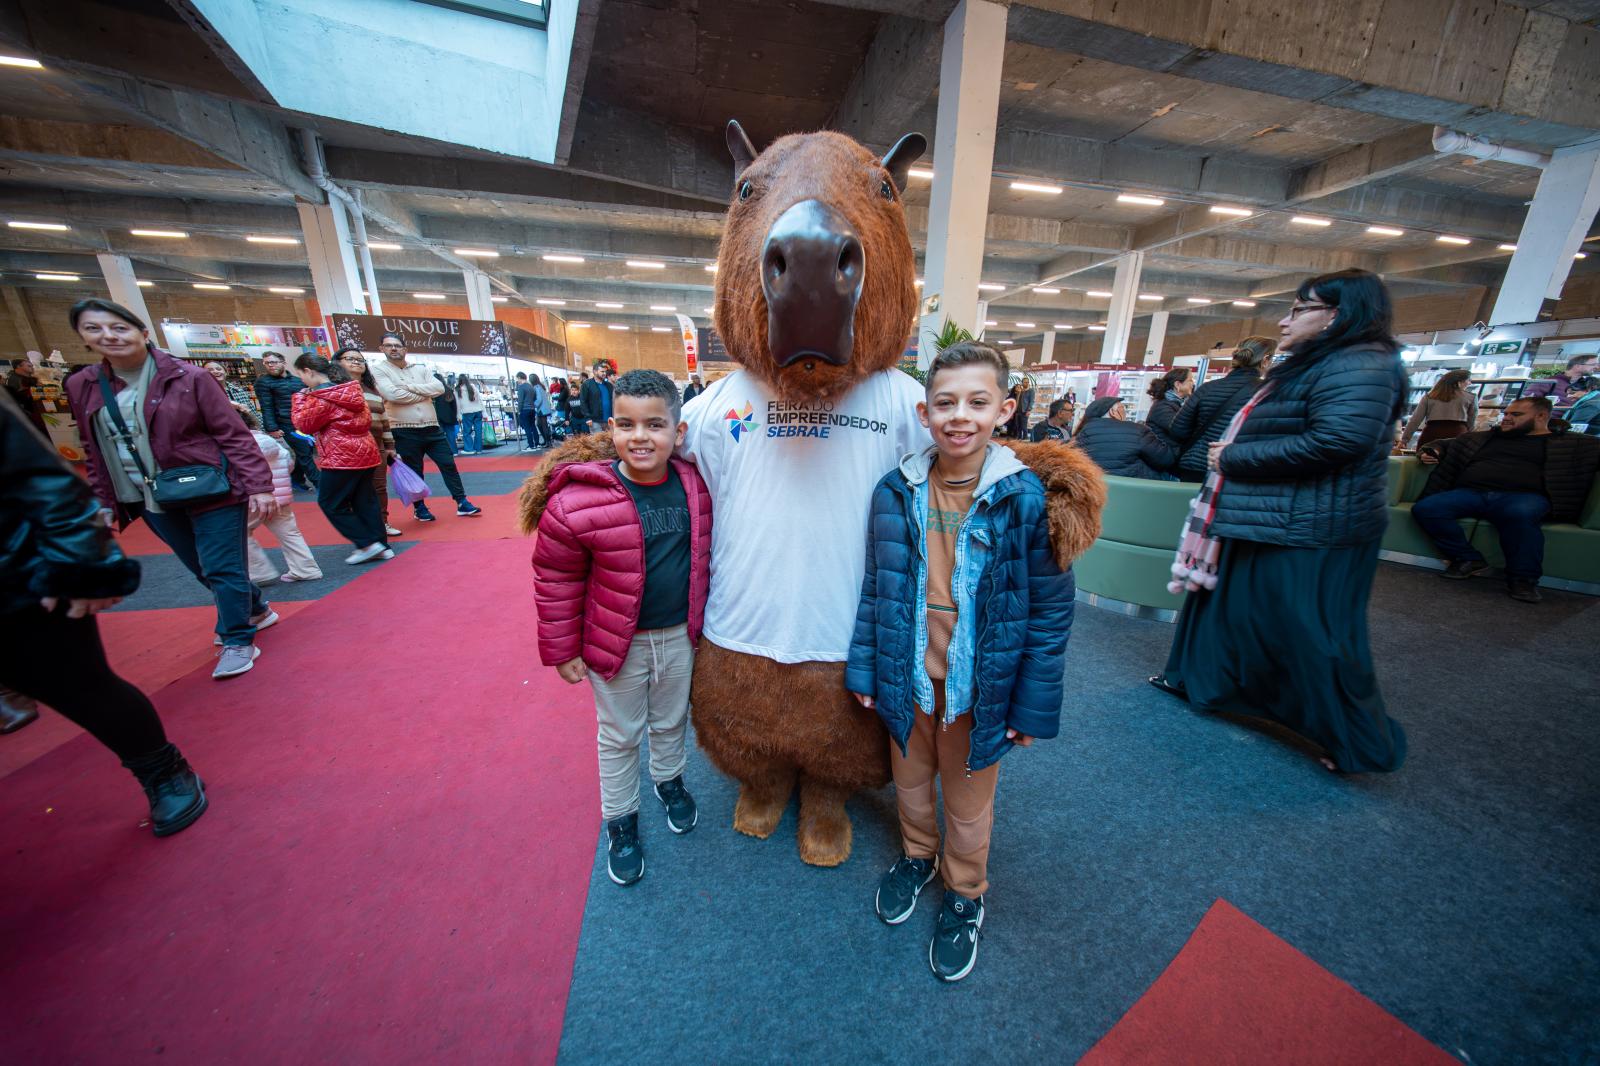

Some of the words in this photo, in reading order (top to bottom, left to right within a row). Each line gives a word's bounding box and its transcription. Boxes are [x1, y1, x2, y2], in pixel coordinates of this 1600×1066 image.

[382, 318, 460, 335] UNIQUE
[767, 412, 888, 434] EMPREENDEDOR
[767, 425, 831, 438] SEBRAE
